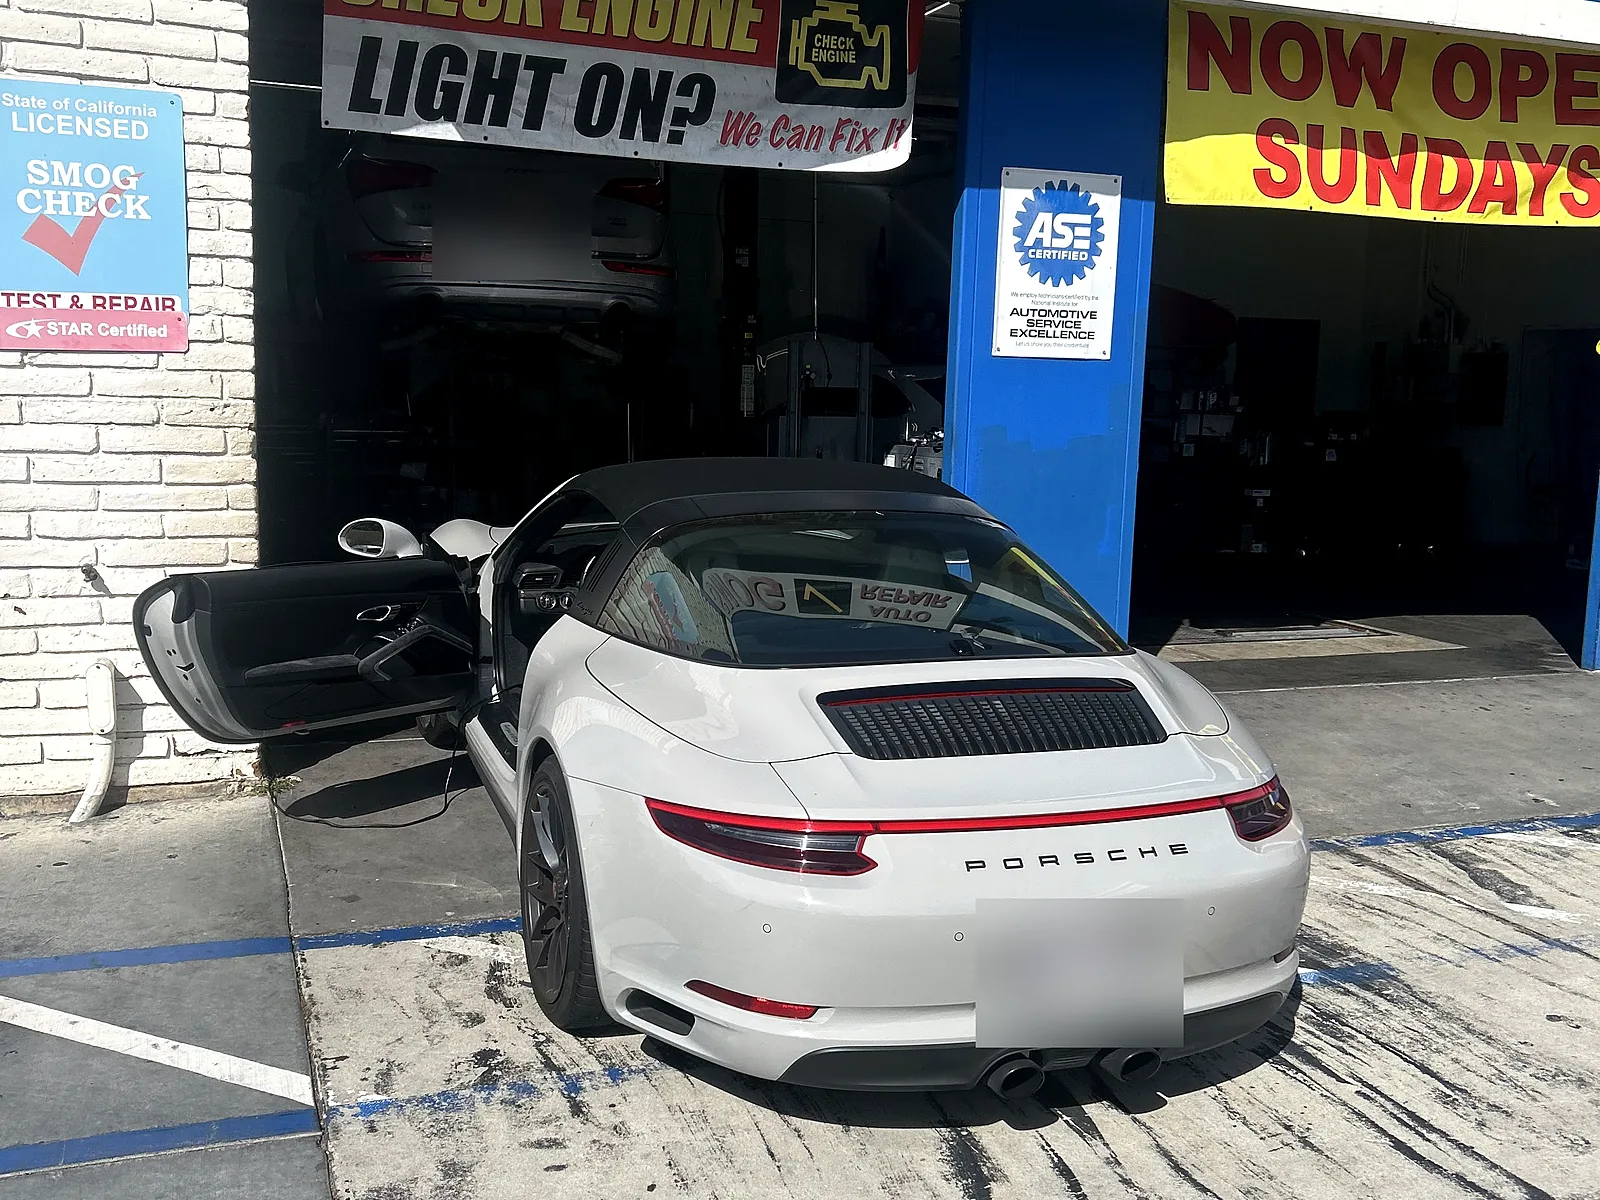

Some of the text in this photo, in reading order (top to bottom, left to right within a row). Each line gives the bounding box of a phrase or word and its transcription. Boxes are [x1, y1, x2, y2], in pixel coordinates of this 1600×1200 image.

[814, 33, 855, 50] CHECK
[811, 48, 856, 63] ENGINE
[1187, 10, 1407, 112] NOW
[347, 36, 716, 146] LIGHT ON?
[1, 92, 157, 118] State of California
[11, 111, 149, 140] LICENSED
[719, 109, 763, 148] We
[769, 113, 825, 151] Can
[829, 117, 879, 153] Fix
[26, 159, 139, 191] SMOG
[1252, 118, 1600, 219] SUNDAYS
[16, 188, 152, 220] CHECK
[1023, 211, 1092, 250] ASE
[1028, 249, 1089, 261] CERTIFIED
[0, 292, 177, 312] TEST & REPAIR
[1009, 307, 1098, 320] AUTOMOTIVE
[47, 321, 168, 338] STAR Certified
[1009, 328, 1096, 340] EXCELLENCE
[1026, 319, 1082, 329] SERVICE
[964, 842, 1190, 873] PORSCHE
